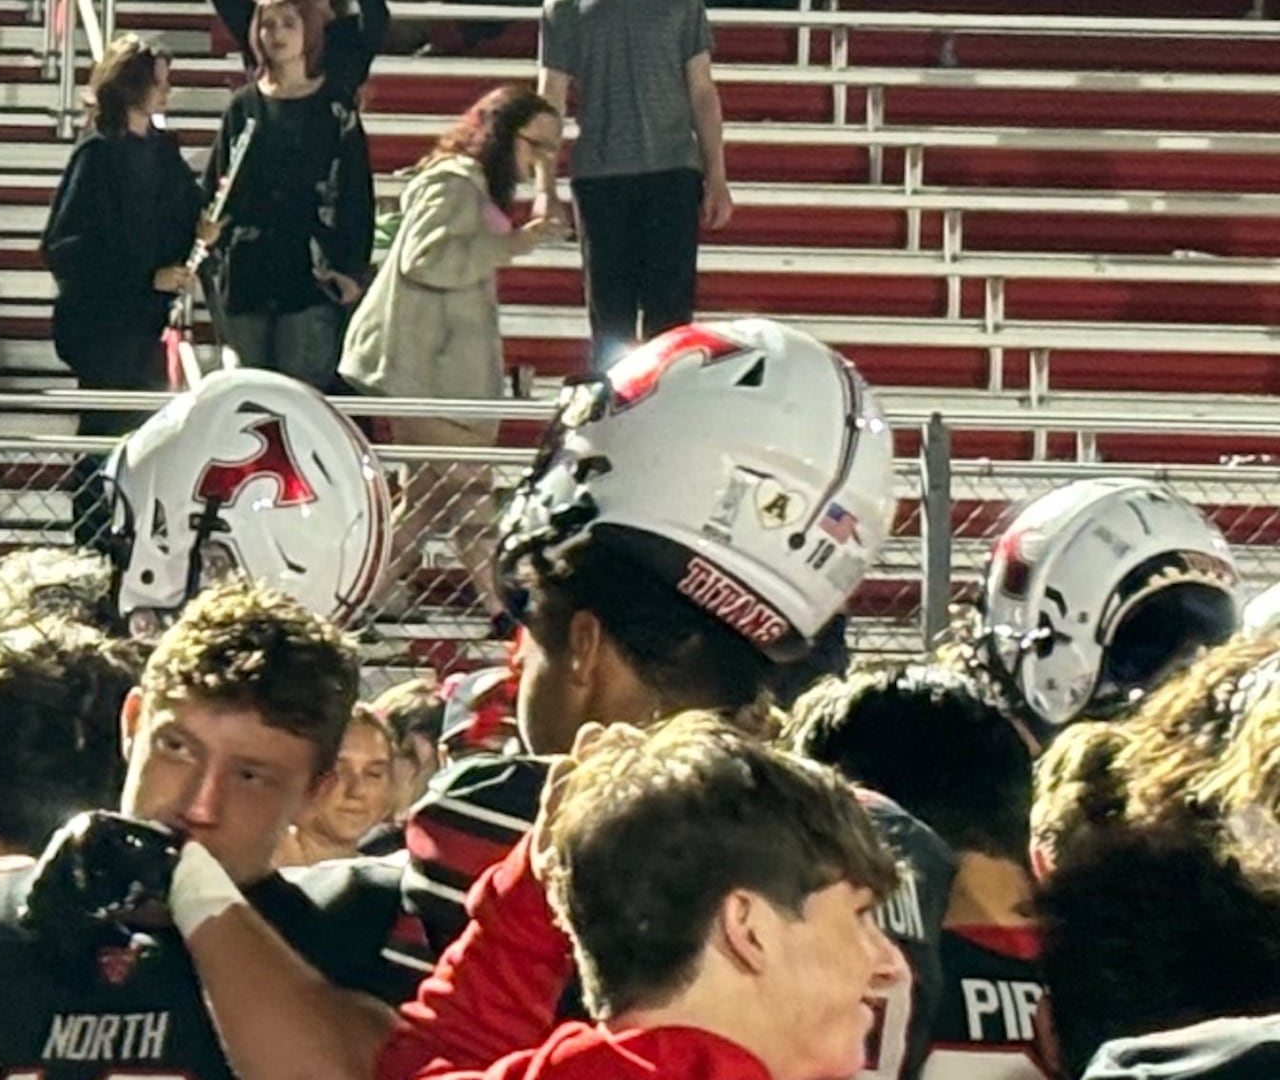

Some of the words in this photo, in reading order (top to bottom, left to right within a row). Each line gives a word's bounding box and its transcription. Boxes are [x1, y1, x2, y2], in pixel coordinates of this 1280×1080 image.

[676, 556, 790, 645] TITANS
[41, 1011, 169, 1061] NORTH
[960, 977, 1050, 1042] PIR
